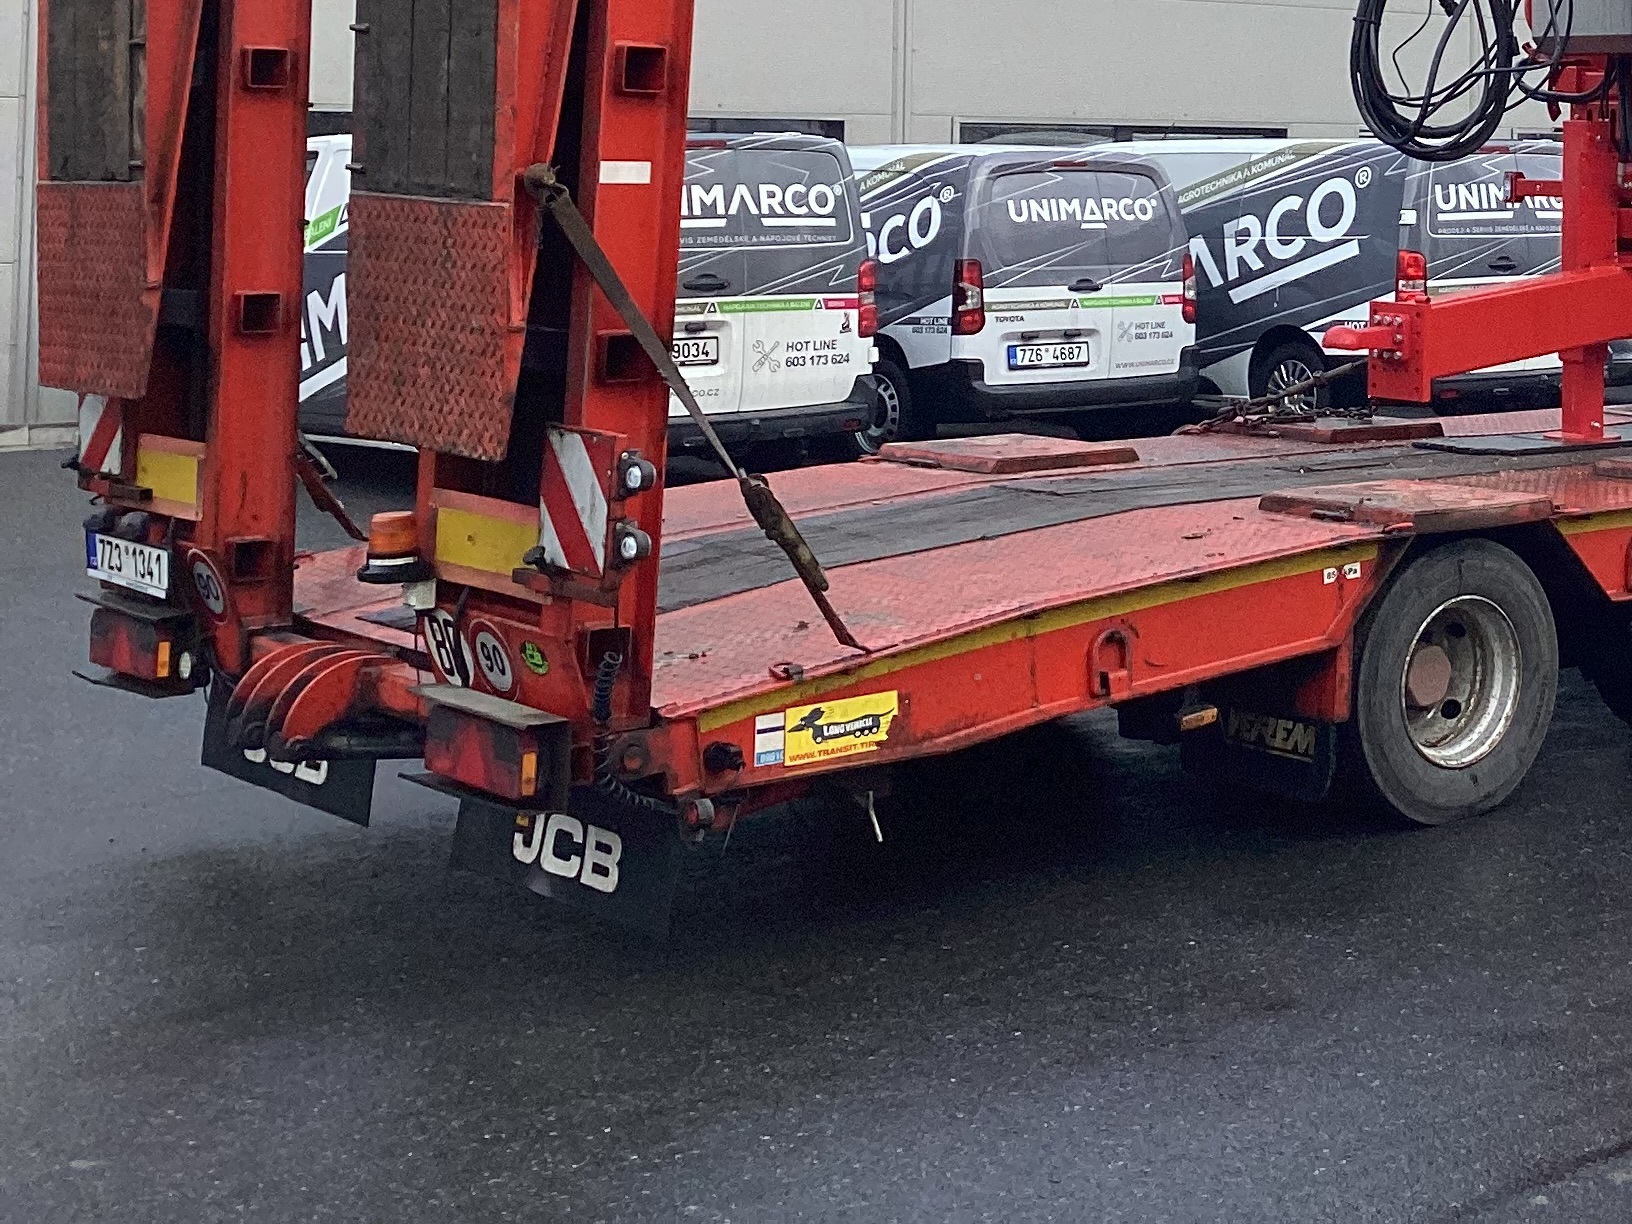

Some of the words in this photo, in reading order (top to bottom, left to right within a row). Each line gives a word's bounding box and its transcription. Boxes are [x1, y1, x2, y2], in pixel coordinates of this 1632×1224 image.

[680, 183, 836, 216] IMARCO
[995, 315, 1025, 323] TOYOTA
[786, 341, 811, 352] HOT
[813, 339, 838, 351] LINE
[1019, 348, 1043, 363] 7Z6
[1052, 346, 1082, 362] 4687
[785, 356, 806, 367] 603
[809, 354, 828, 366] 173
[831, 353, 850, 364] 624
[98, 538, 122, 573] 7Z3
[131, 546, 162, 585] 1341
[479, 641, 507, 676] 90
[512, 813, 622, 893] JCB
